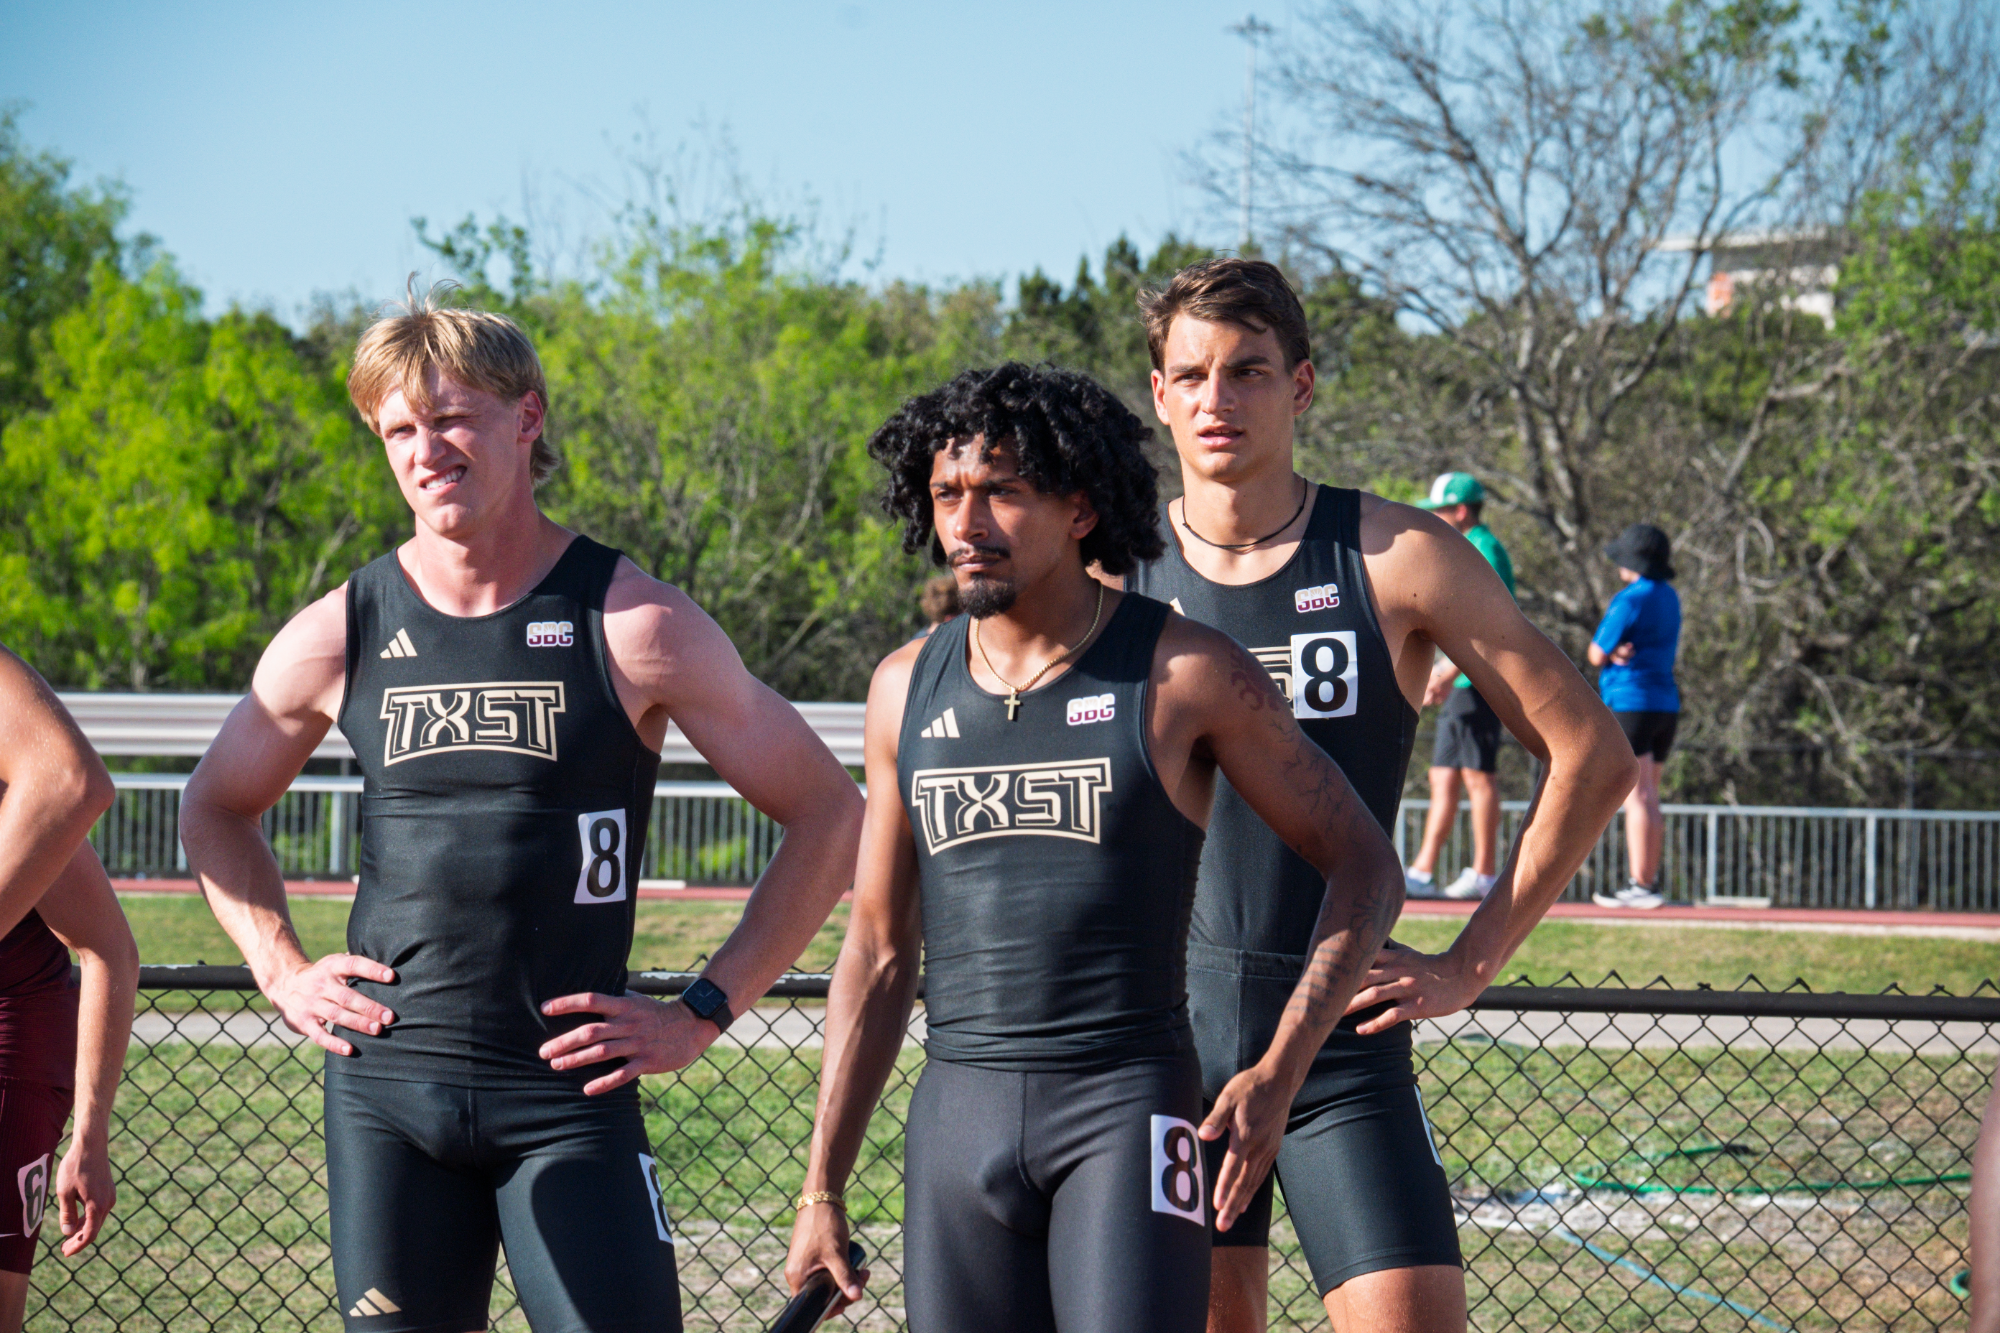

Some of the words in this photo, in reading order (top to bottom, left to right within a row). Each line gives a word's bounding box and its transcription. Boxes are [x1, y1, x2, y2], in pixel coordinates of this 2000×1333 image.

[527, 621, 573, 647] SBC
[1295, 584, 1340, 613] SBC
[1067, 693, 1115, 726] SBC
[1301, 638, 1348, 712] 8
[386, 686, 559, 757] TXST
[916, 765, 1104, 846] TXST
[587, 818, 620, 897] 8
[25, 1165, 43, 1230] 6
[1162, 1126, 1199, 1212] 8
